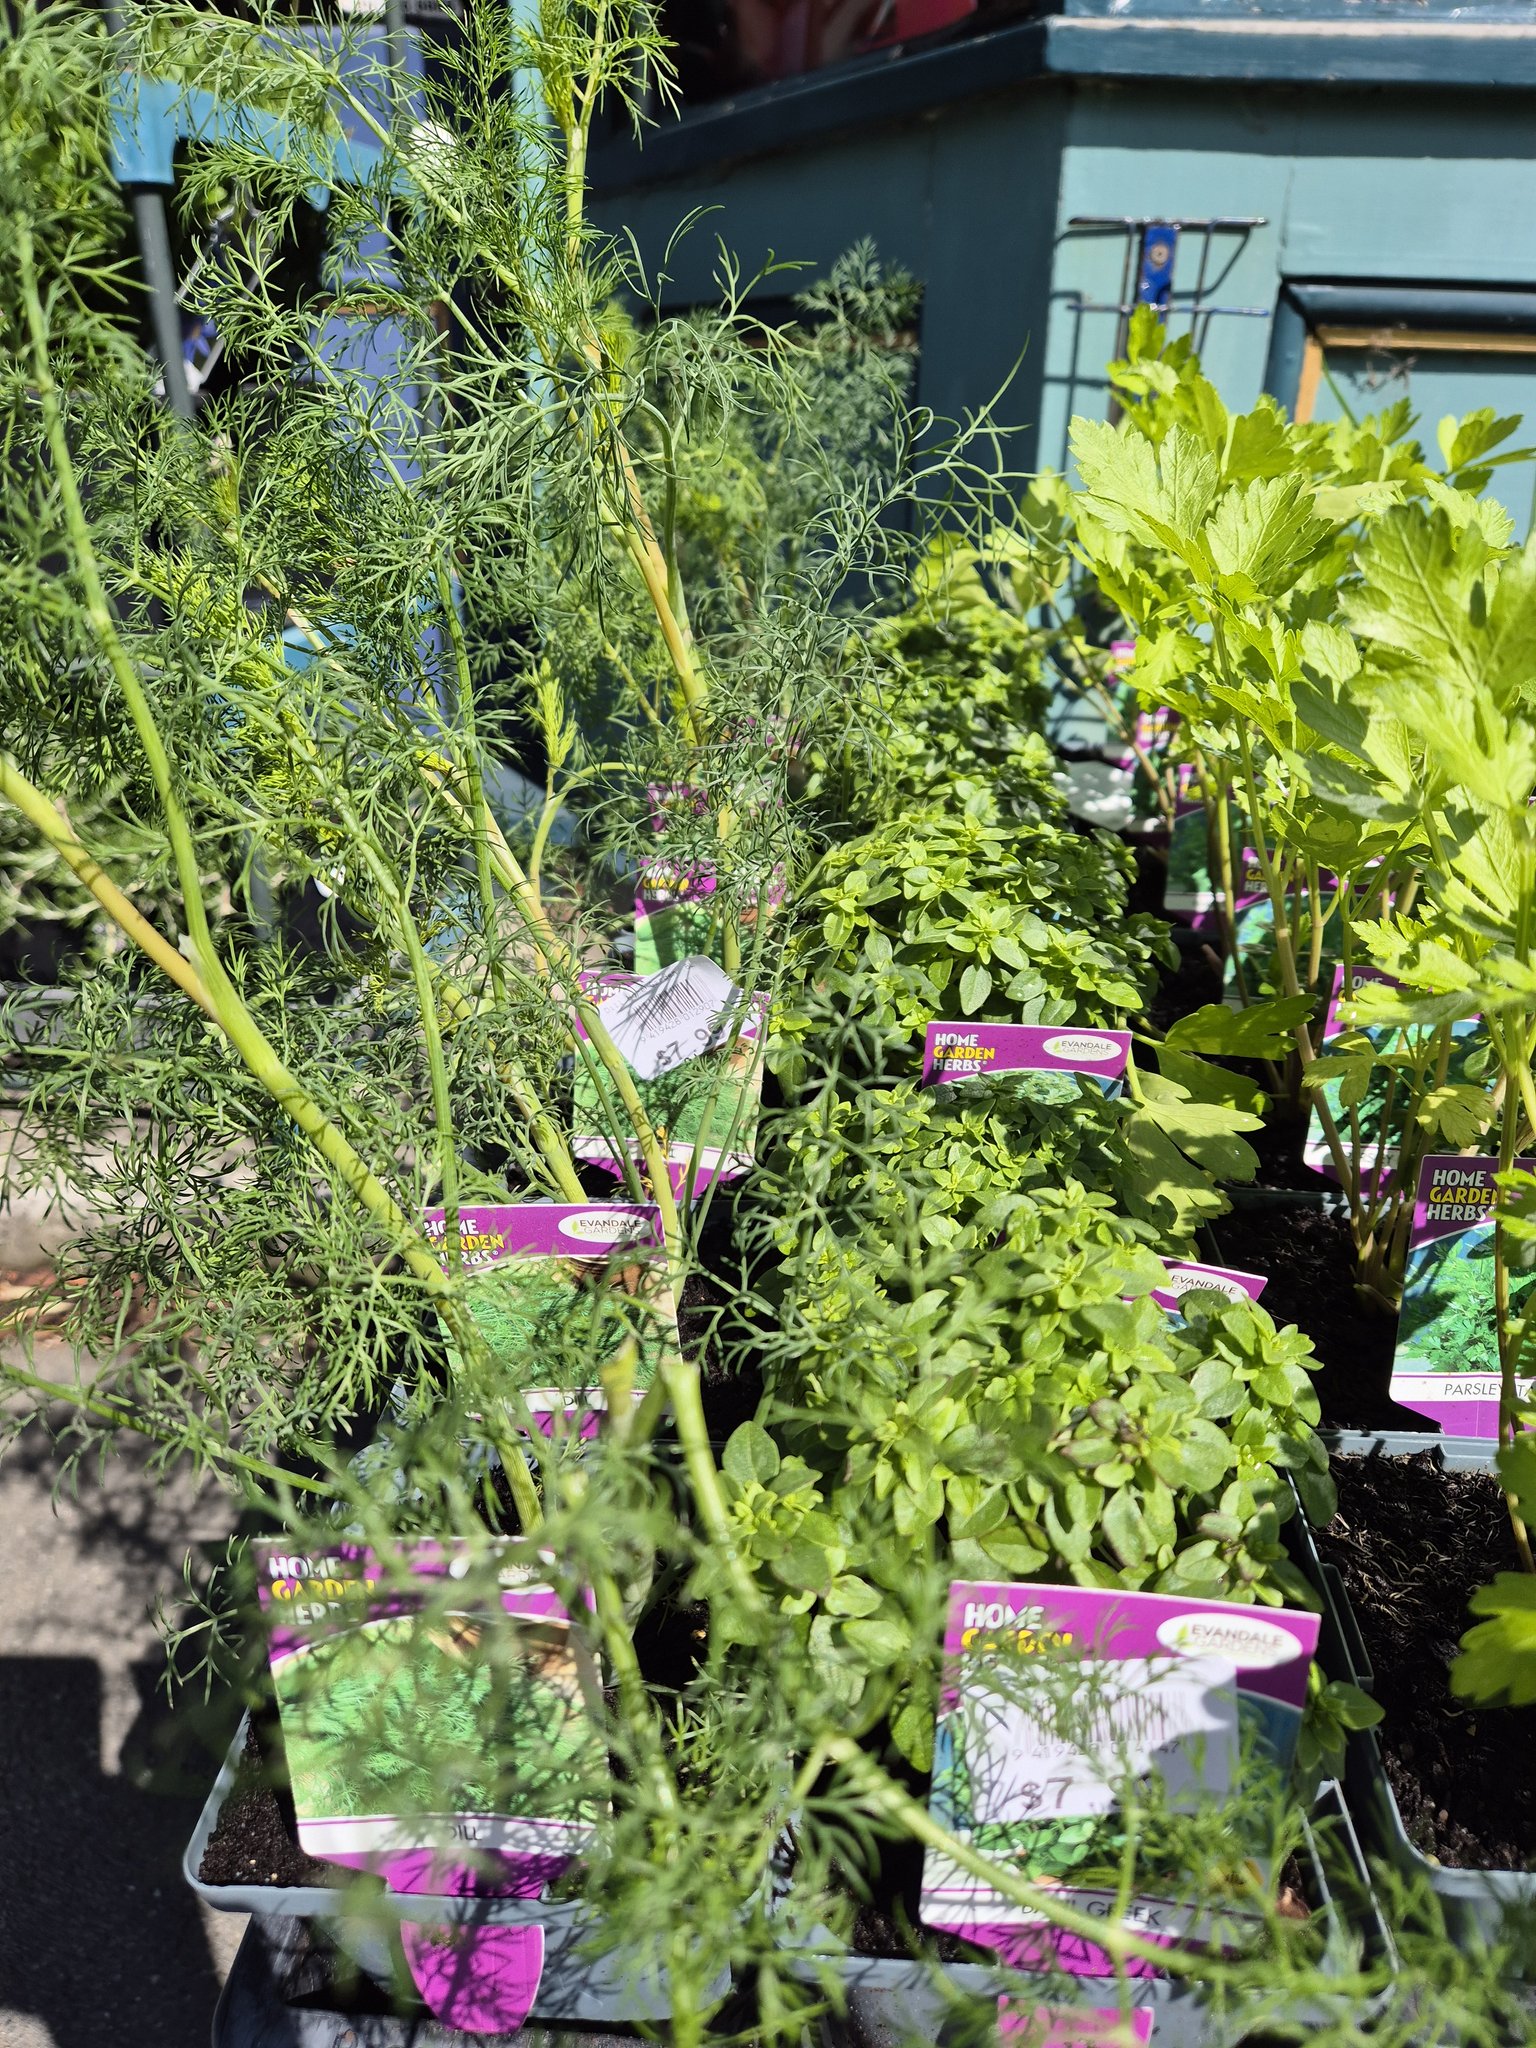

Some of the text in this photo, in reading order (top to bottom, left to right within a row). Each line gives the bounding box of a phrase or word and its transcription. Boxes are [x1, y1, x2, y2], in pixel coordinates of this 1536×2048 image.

[935, 1033, 979, 1046] HOME
[1061, 1041, 1112, 1050] EVANDALE
[933, 1045, 995, 1060] GARDEN
[932, 1058, 982, 1072] HERBS
[1432, 1169, 1487, 1187] HOME
[1426, 1203, 1487, 1221] HERBS
[579, 1219, 642, 1228] EVANDALE
[1171, 1274, 1238, 1295] EVANDALE
[1191, 1624, 1284, 1647] EVANDALE
